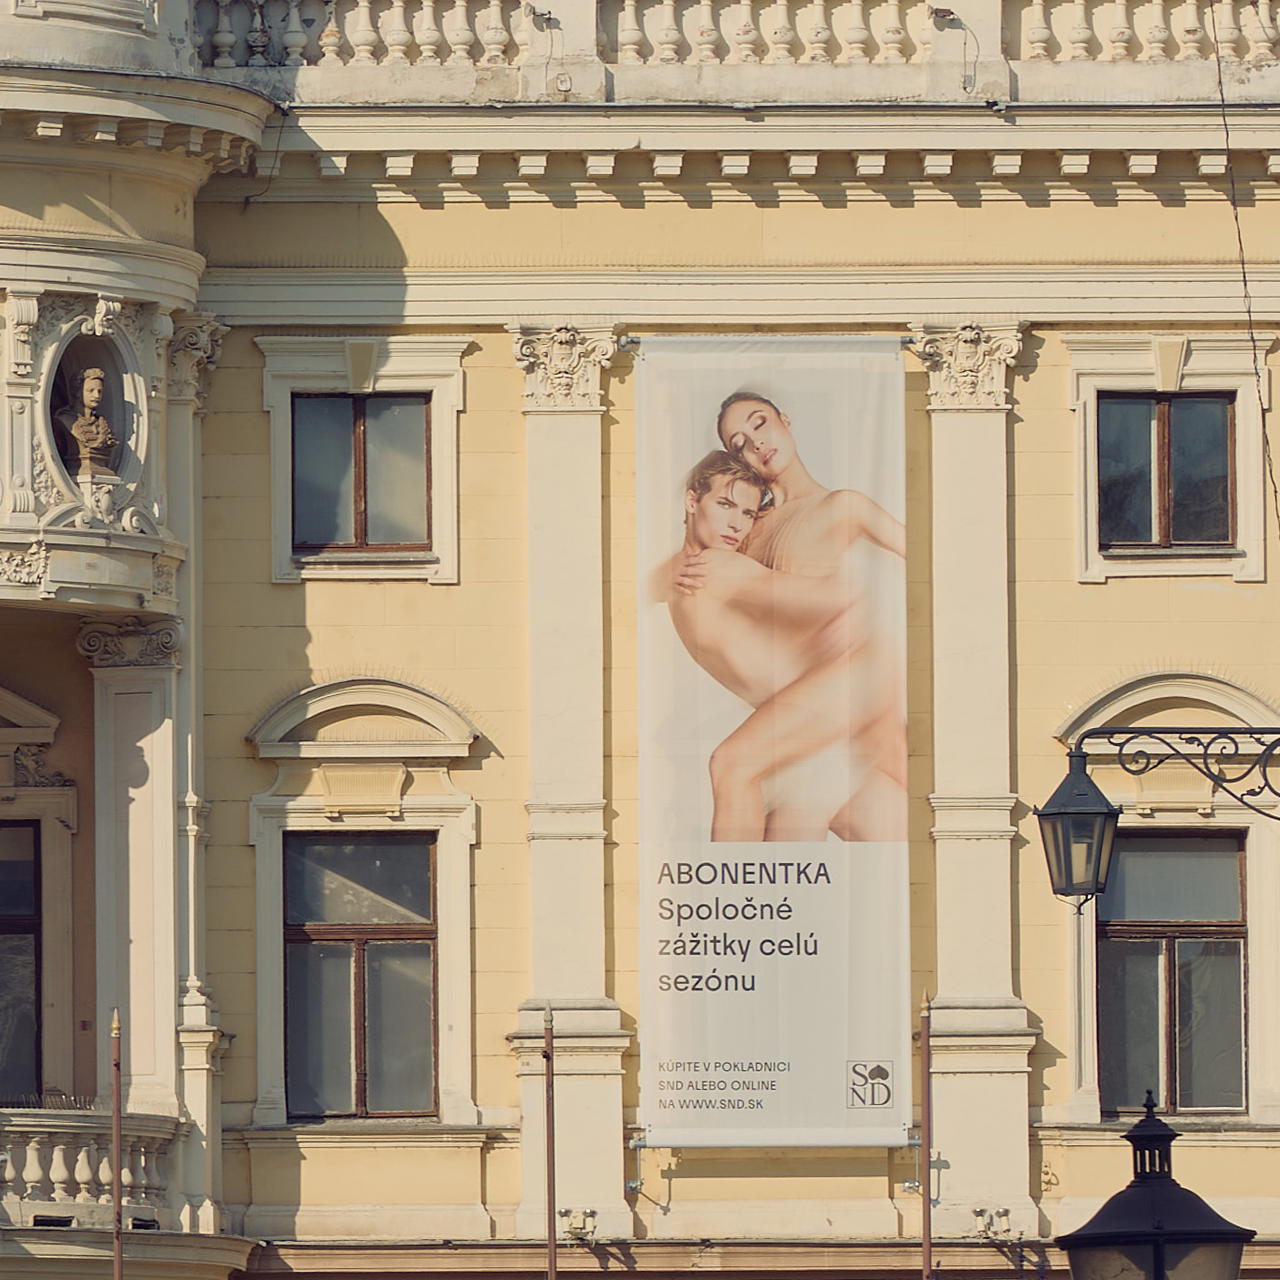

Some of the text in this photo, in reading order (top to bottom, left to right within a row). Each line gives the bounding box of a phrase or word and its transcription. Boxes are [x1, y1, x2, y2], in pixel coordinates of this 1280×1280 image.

[657, 862, 831, 885] ABONENTKA
[658, 897, 793, 927] Spoločné
[658, 932, 818, 962] zážitky celú
[658, 968, 756, 992] sezónu
[658, 1059, 791, 1072] KÚPITE V POKLADNICI
[658, 1080, 777, 1091] SND ALEBO ONLINE
[658, 1099, 764, 1110] NA WWW.SND.SK
